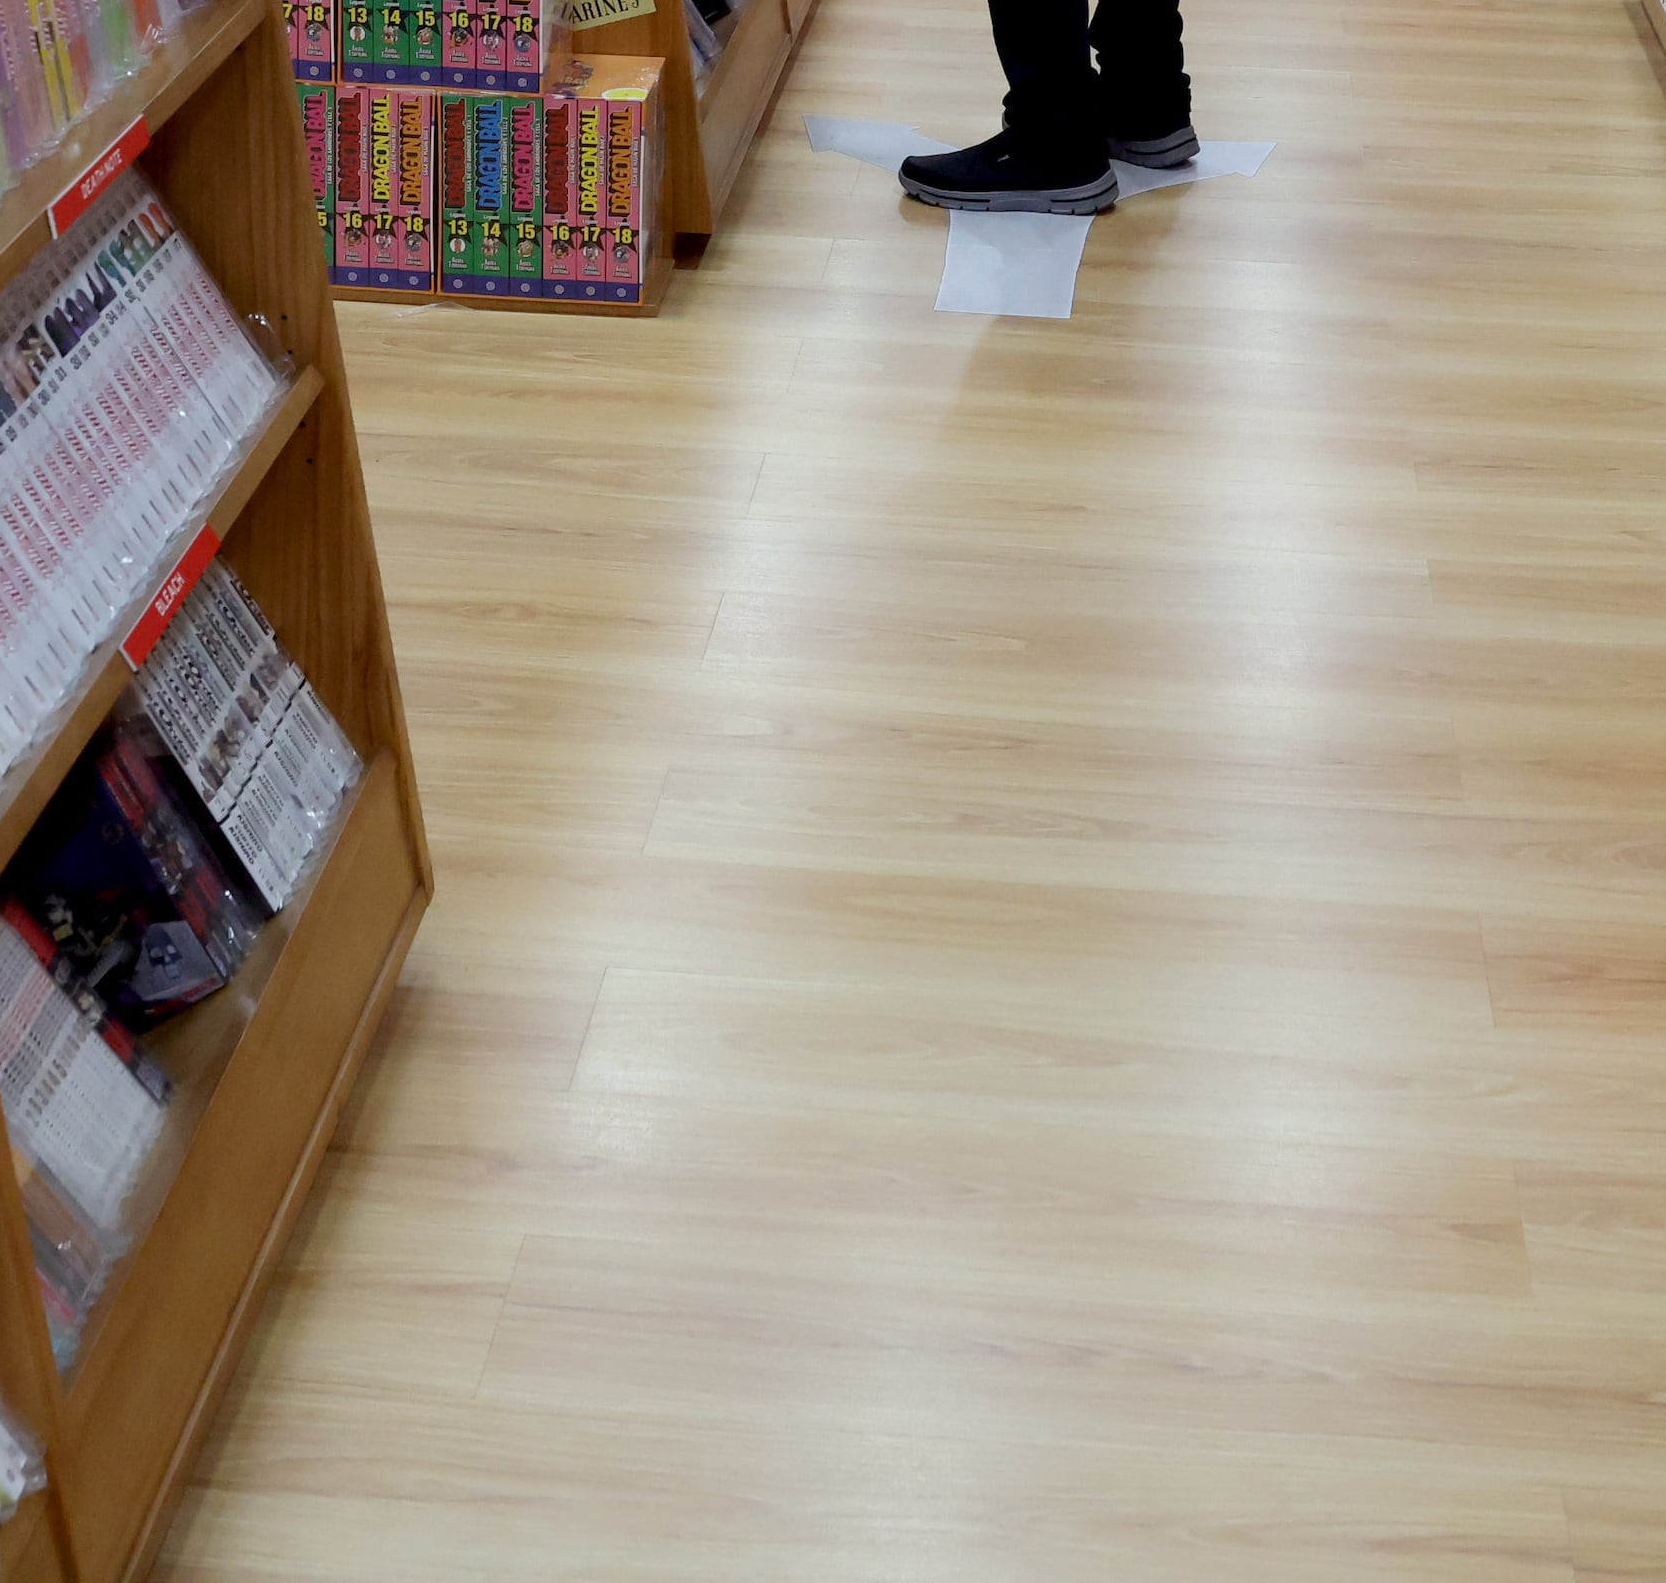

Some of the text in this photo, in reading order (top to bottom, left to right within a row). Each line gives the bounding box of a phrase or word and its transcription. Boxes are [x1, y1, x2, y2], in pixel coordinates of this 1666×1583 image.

[304, 5, 325, 22] 18
[347, 7, 368, 23] 13
[381, 9, 401, 25] 14
[415, 11, 436, 26] 15
[449, 12, 469, 28] 16
[481, 14, 501, 30] 17
[513, 17, 533, 33] 18
[80, 147, 124, 200] DEATH NOTE
[342, 213, 363, 229] 16
[373, 214, 393, 230] 17
[404, 216, 424, 233] 18
[448, 219, 468, 235] 13
[481, 221, 502, 237] 14
[515, 223, 536, 240] 15
[549, 225, 570, 241] 16
[582, 226, 602, 243] 17
[612, 228, 633, 245] 18
[155, 570, 187, 618] BLEACH
